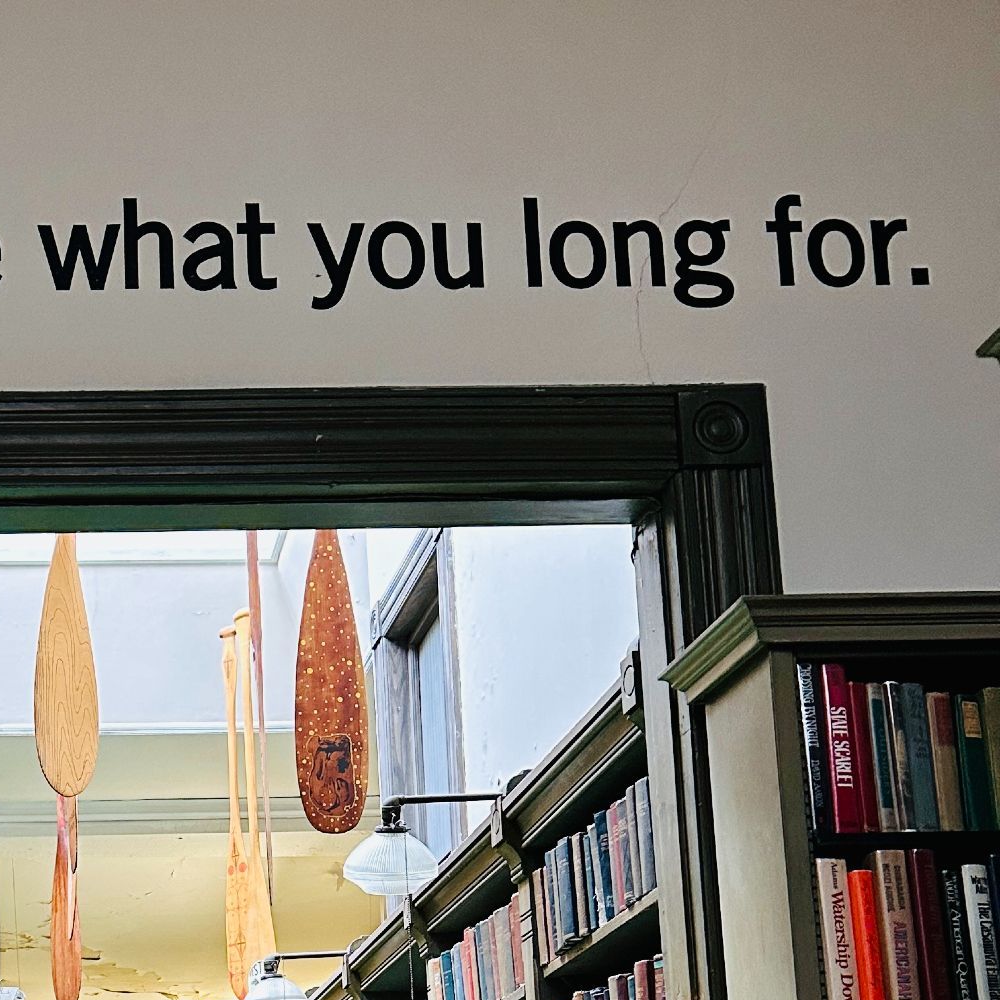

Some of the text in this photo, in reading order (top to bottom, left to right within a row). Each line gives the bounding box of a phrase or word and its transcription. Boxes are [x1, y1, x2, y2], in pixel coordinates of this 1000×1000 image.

[38, 198, 277, 291] what
[307, 221, 484, 310] you
[523, 198, 734, 308] long
[766, 195, 929, 287] for.
[807, 717, 820, 748] NIGHT
[830, 706, 854, 789] STATE SCARLET
[831, 861, 839, 890] Adams
[831, 890, 850, 969] Watership
[950, 909, 966, 961] American
[980, 921, 995, 966] Casanova
